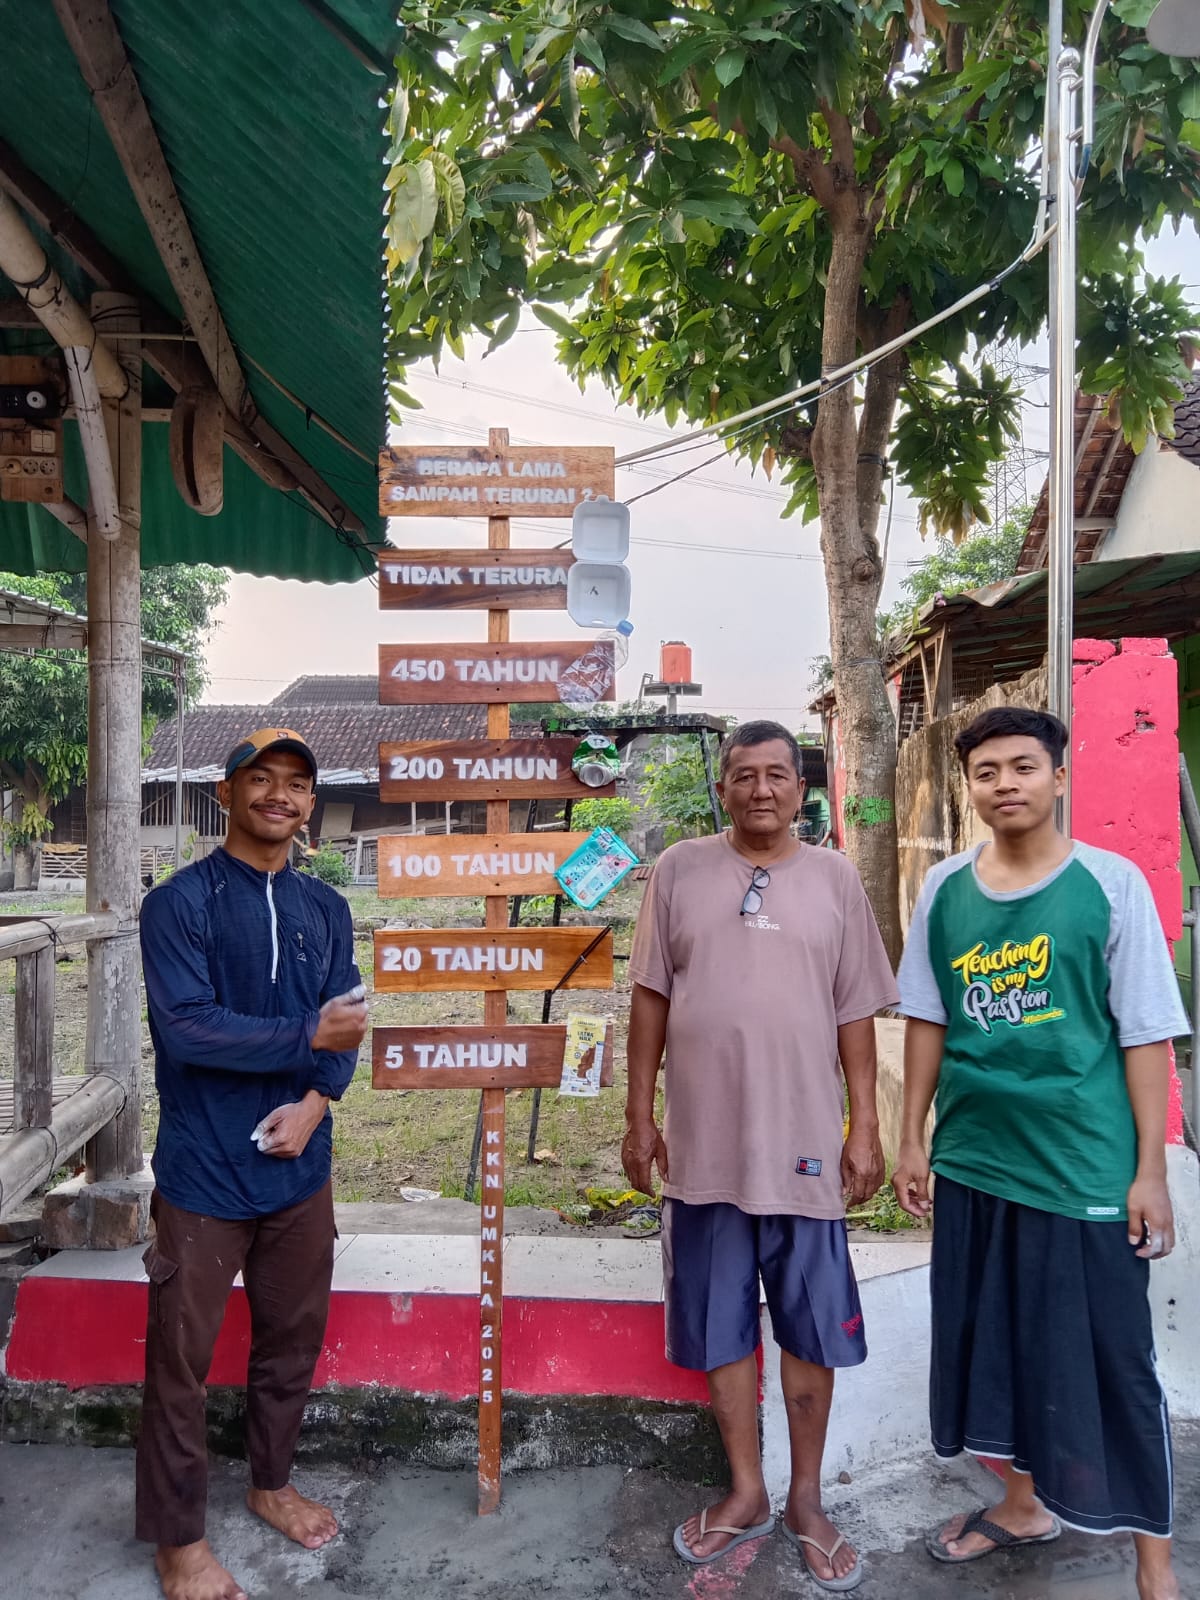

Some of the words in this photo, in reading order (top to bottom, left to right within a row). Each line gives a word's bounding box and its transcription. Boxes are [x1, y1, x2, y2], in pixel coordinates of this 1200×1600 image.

[418, 459, 501, 477] BERAPA
[508, 462, 566, 478] LAMA
[391, 486, 478, 502] SAMPAH
[484, 487, 575, 504] TERURAI
[386, 566, 464, 585] TIDAK
[469, 567, 569, 585] TERURA
[391, 660, 445, 682] 450
[454, 660, 558, 682] TAHUN
[390, 757, 444, 780] 200
[453, 758, 557, 780] TAHUN
[388, 855, 441, 878] 100
[452, 853, 555, 876] TAHUN
[382, 947, 421, 971] 20
[432, 947, 543, 971] TAHUN
[951, 934, 1049, 986] Teaching
[991, 977, 1006, 993] is
[1005, 972, 1026, 989] my
[385, 1045, 404, 1068] 5
[414, 1043, 527, 1067] TAHUN
[486, 1130, 500, 1188] KKN
[480, 1205, 497, 1307] UMKLA
[481, 1324, 493, 1403] 2025
